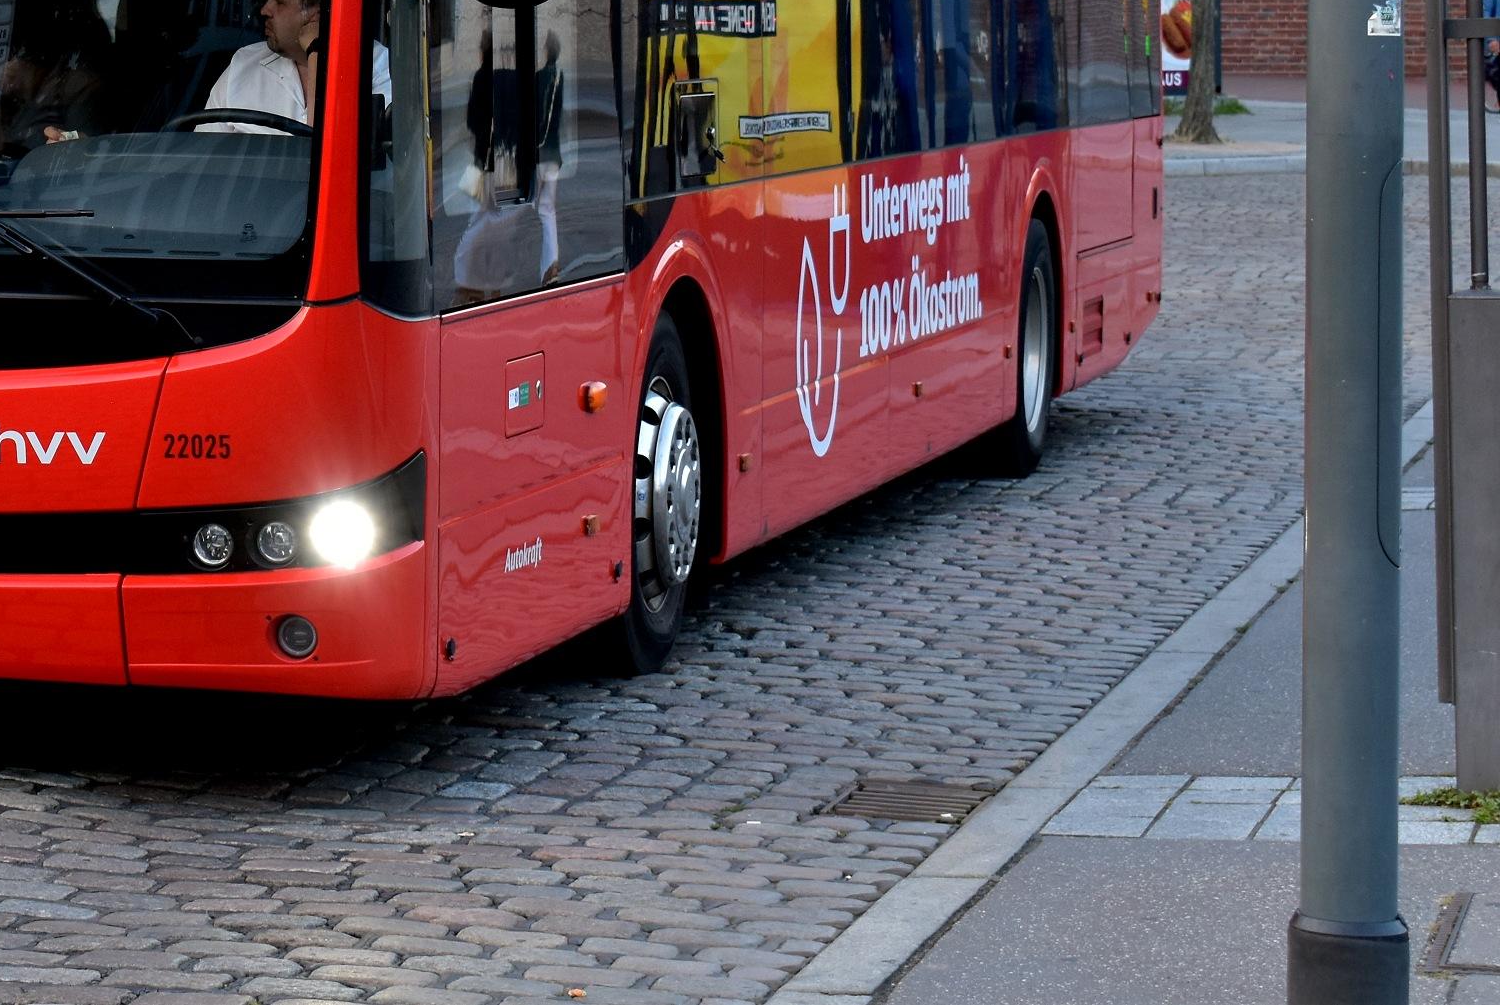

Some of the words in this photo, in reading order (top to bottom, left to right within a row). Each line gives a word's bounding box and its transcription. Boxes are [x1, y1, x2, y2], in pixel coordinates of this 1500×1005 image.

[860, 173, 943, 246] Unterwegs
[946, 154, 970, 224] mit
[859, 277, 906, 358] 100%
[909, 255, 983, 341] Ökostrom.
[163, 433, 232, 460] 22025
[504, 537, 543, 574] Autokraft
